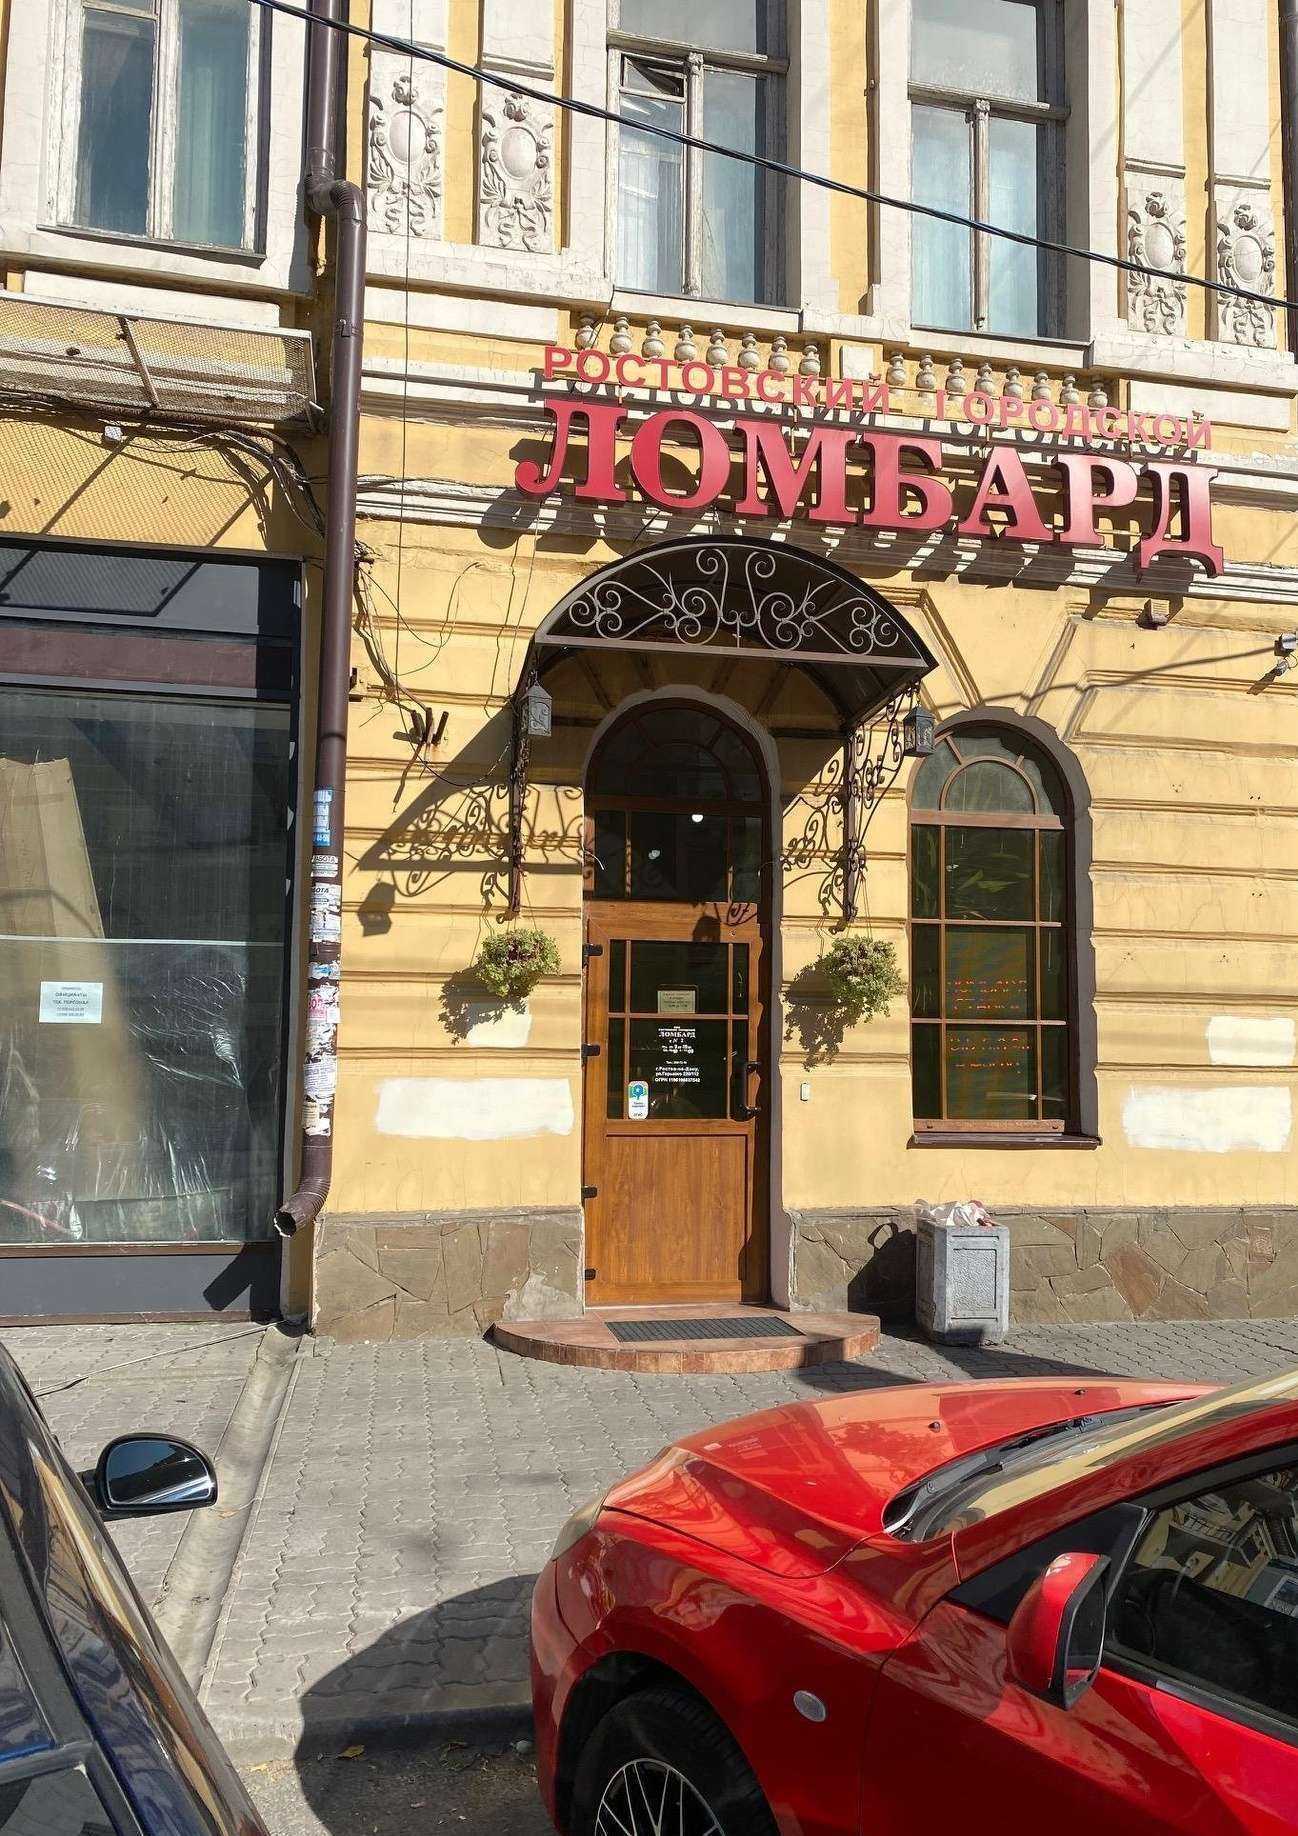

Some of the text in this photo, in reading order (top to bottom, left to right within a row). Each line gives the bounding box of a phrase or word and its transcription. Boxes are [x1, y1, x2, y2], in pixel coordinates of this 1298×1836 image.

[544, 345, 1212, 450] РОСТОВСКИЙ ГОРОДСКОЙ
[514, 398, 1225, 578] ЛОМБАРД
